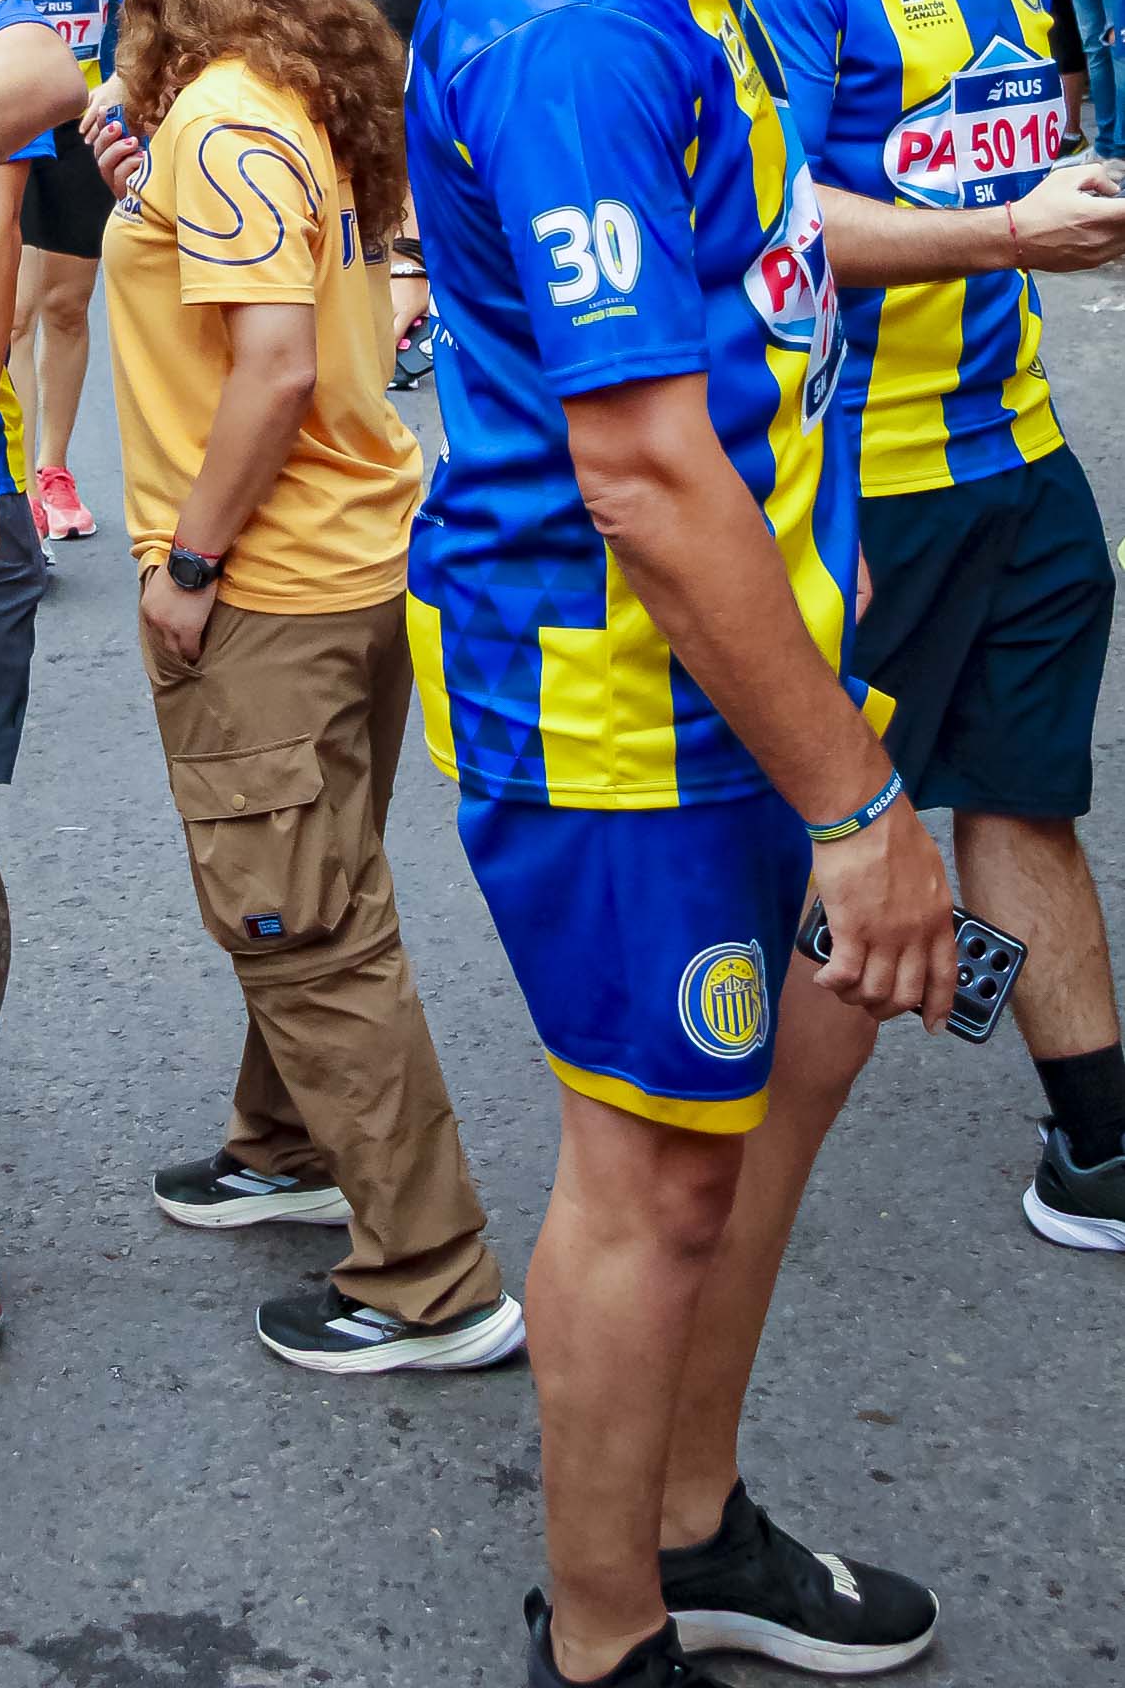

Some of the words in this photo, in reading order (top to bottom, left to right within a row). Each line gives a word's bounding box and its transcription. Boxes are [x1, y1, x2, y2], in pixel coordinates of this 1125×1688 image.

[49, 1, 73, 12] RUS
[905, 9, 947, 22] CANALLA
[1005, 78, 1043, 99] RUS
[972, 110, 1061, 173] 5016
[975, 184, 997, 204] 5K
[532, 199, 641, 306] 30
